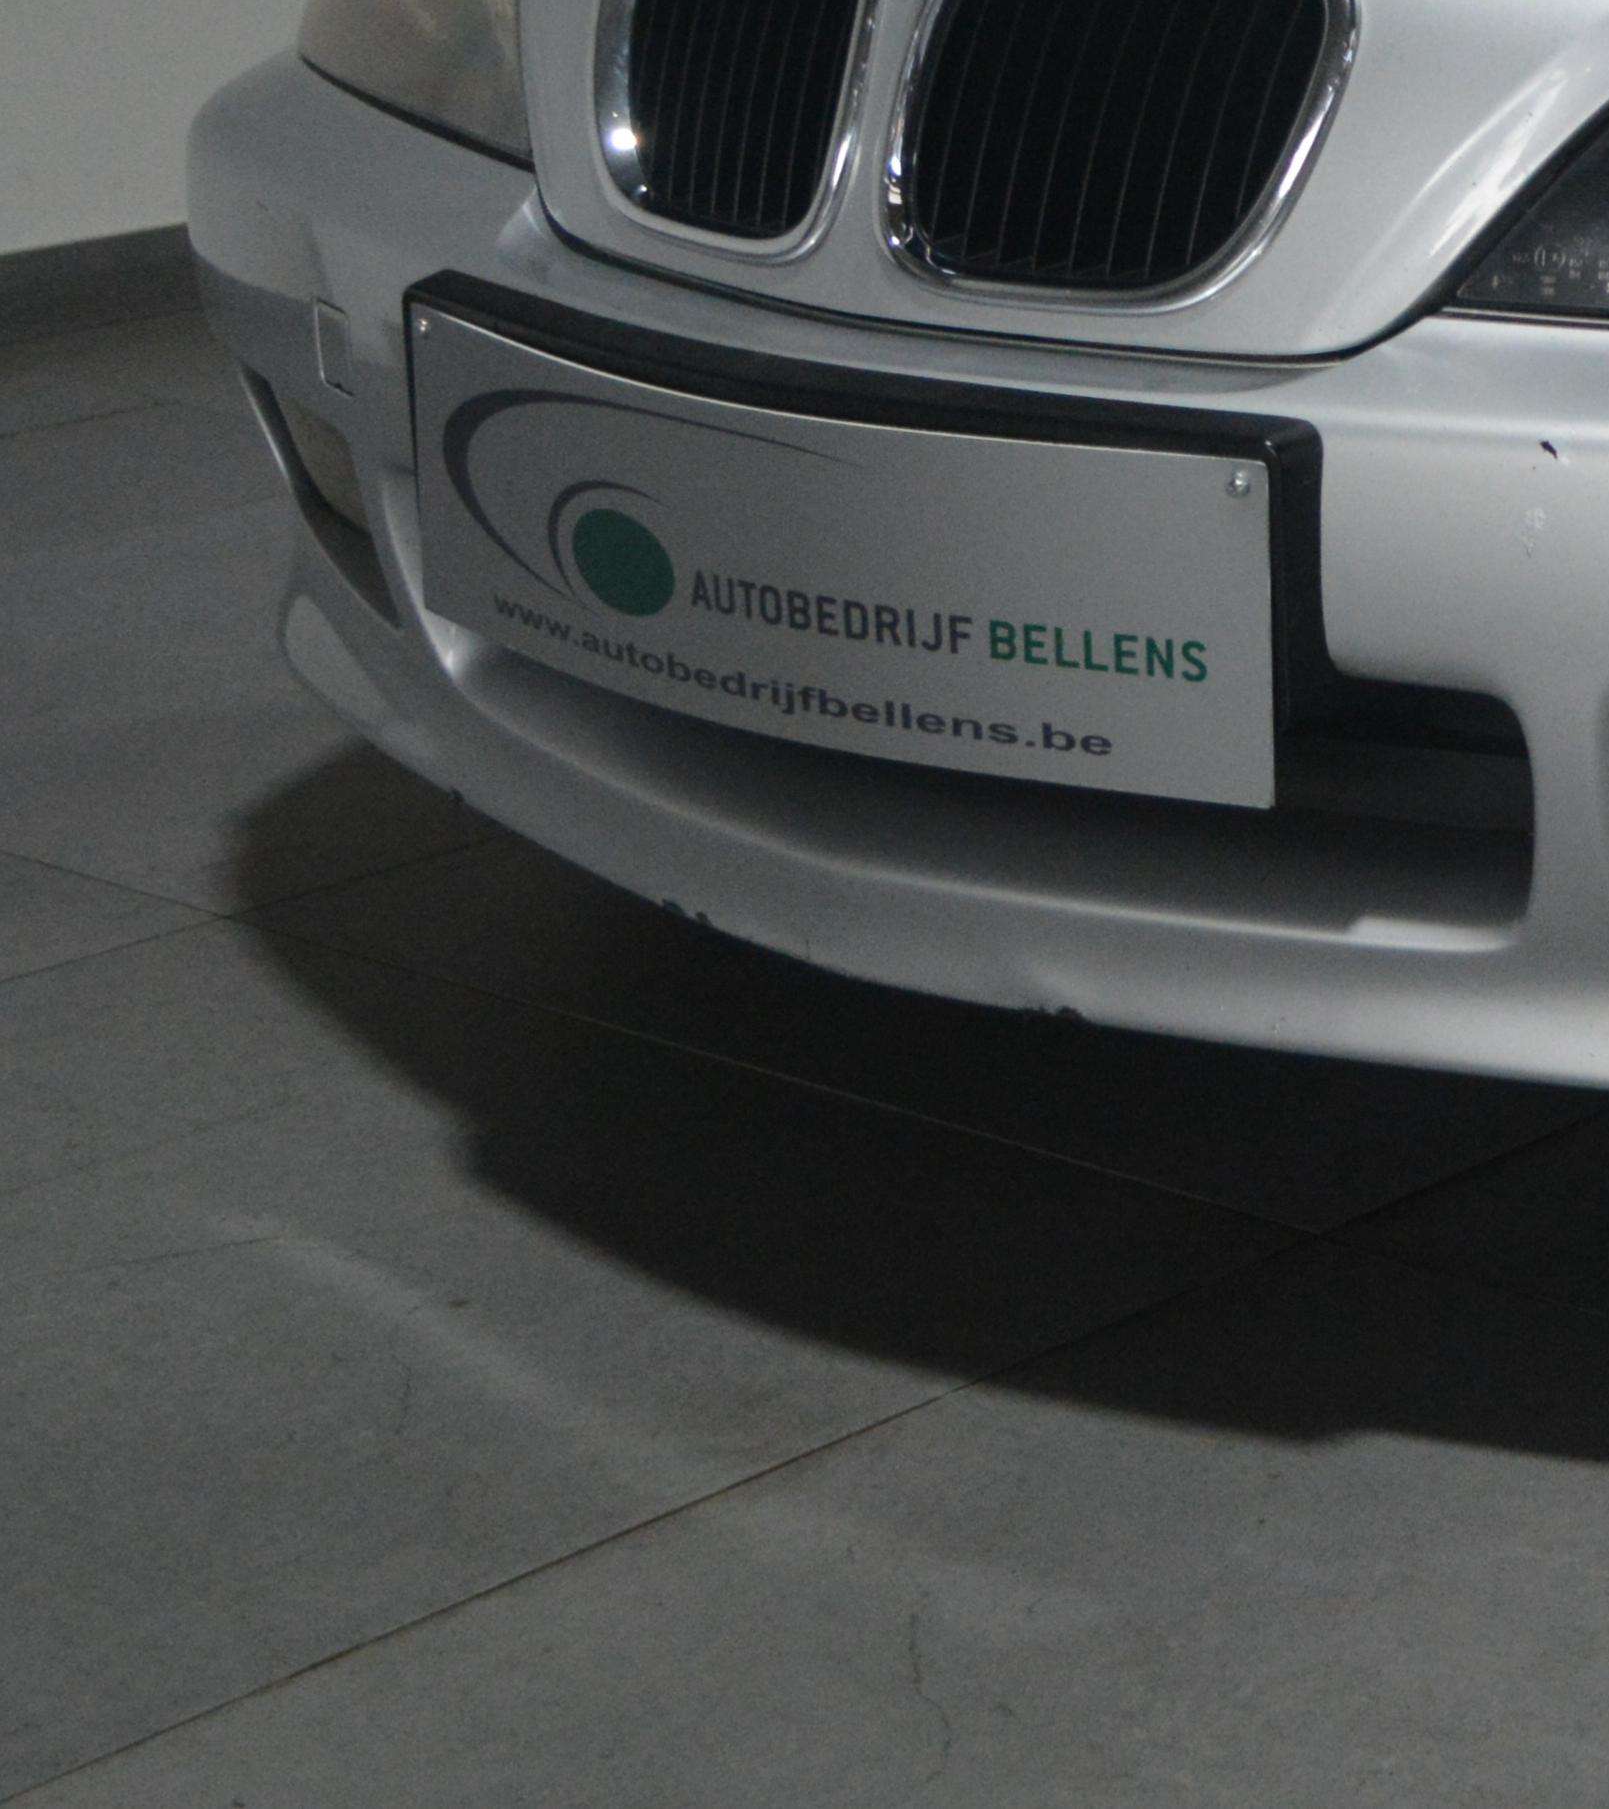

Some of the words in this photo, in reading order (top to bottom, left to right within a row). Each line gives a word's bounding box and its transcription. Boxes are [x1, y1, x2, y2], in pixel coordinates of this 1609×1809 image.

[494, 593, 1115, 758] www.autobedrijfbellens.be
[690, 569, 974, 655] AUTOBEDRIJF
[988, 619, 1209, 684] BELLENS
